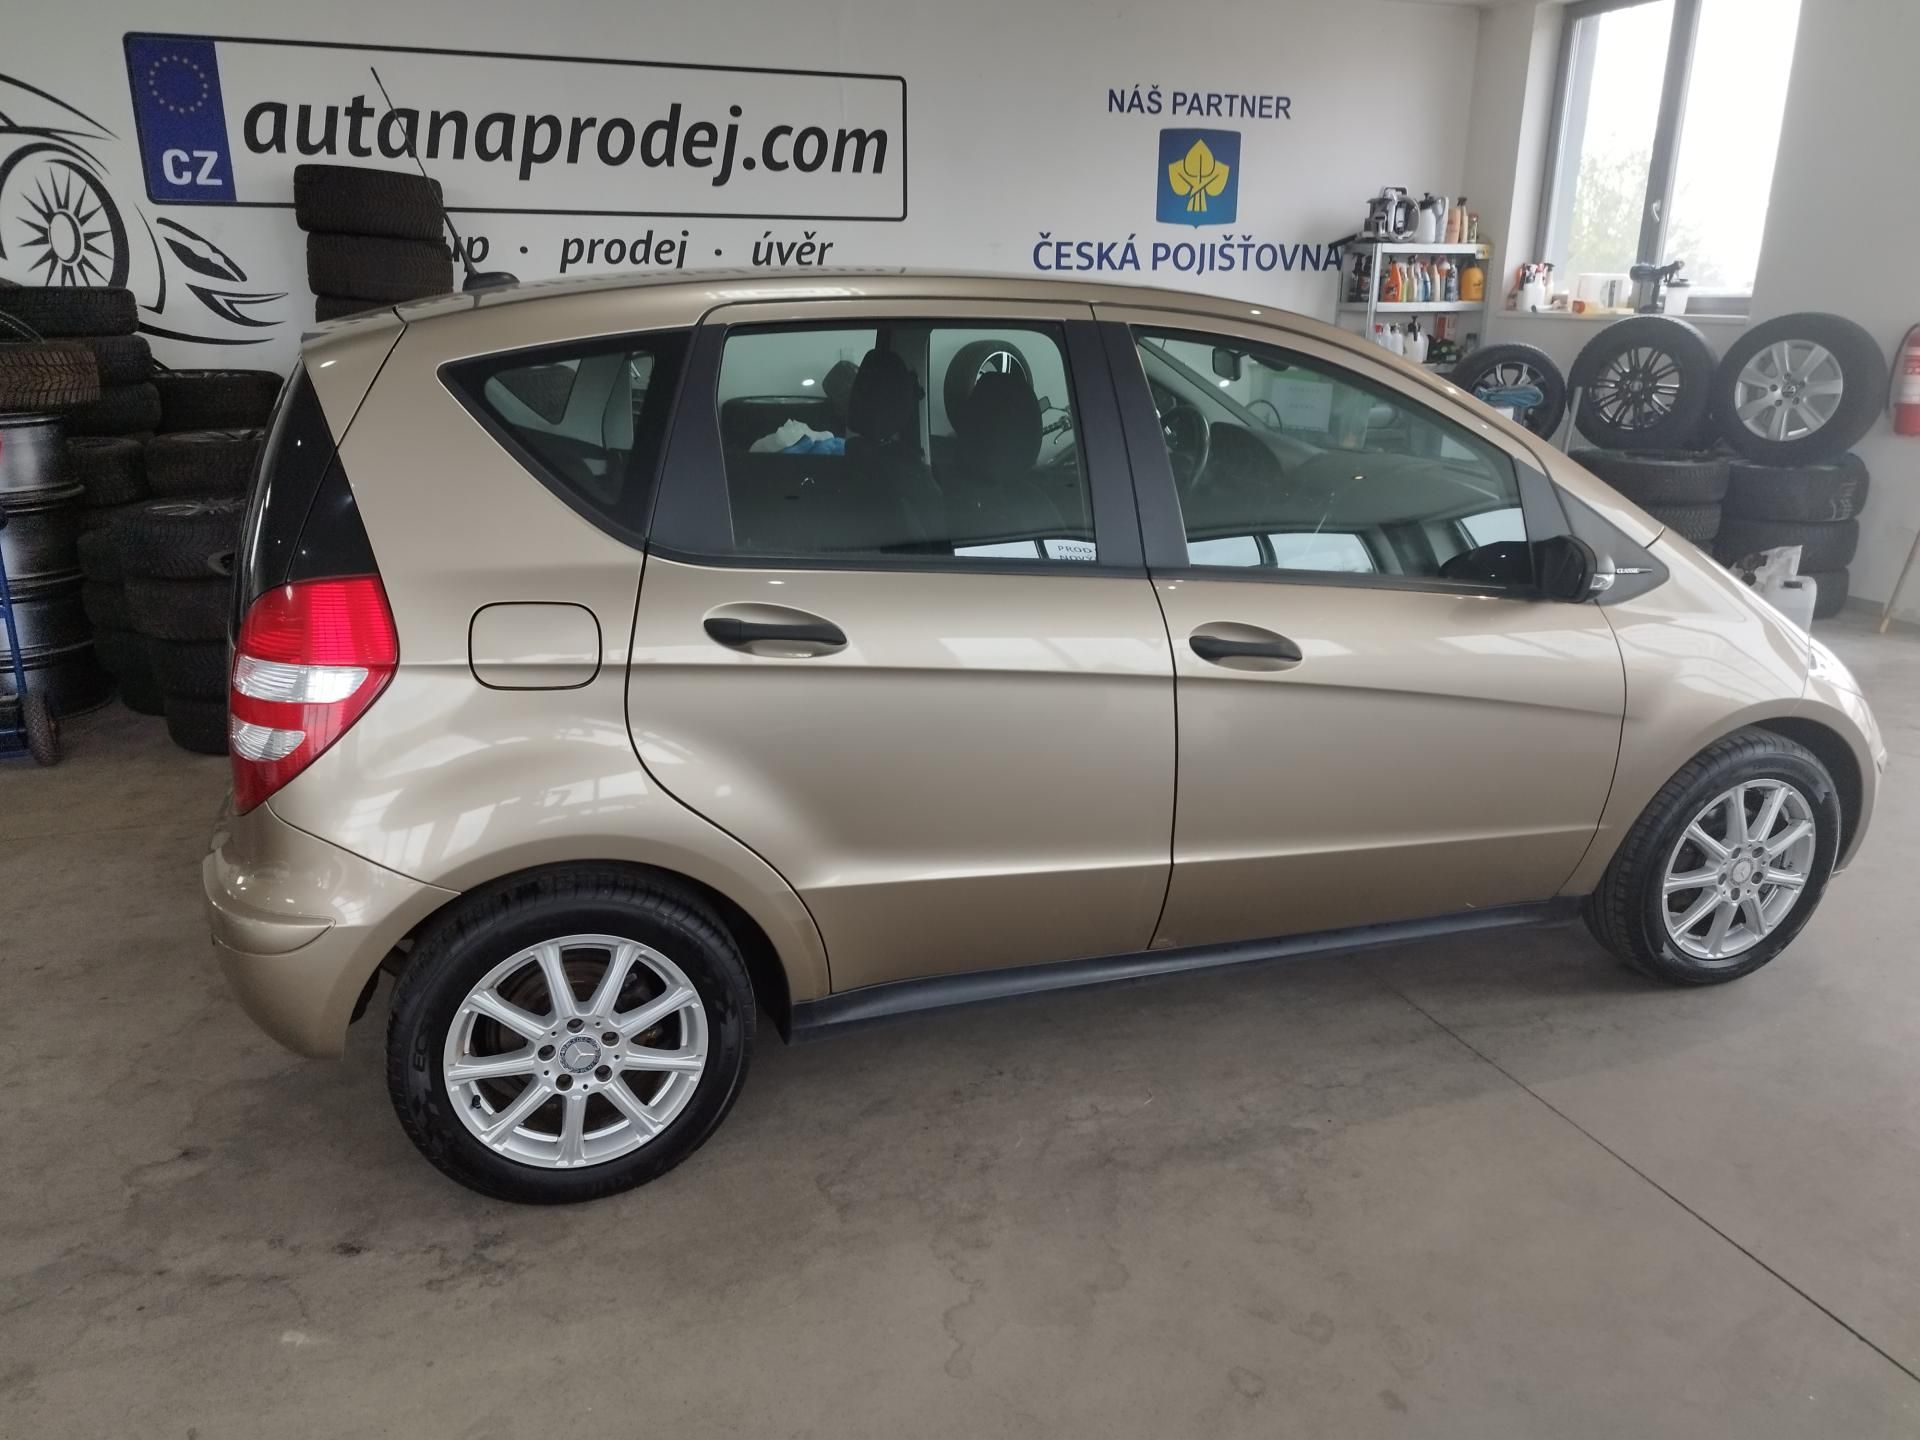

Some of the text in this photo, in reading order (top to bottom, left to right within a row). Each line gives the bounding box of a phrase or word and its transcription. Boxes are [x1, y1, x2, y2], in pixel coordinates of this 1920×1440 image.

[1108, 84, 1292, 119] NÁŠ PARTNER
[243, 95, 889, 188] autanaprodej.com
[162, 148, 223, 186] CZ
[560, 230, 690, 273] prodej
[752, 231, 834, 267] úvěr
[1033, 231, 1342, 276] ČESKÁ POJIŠŤOVNA
